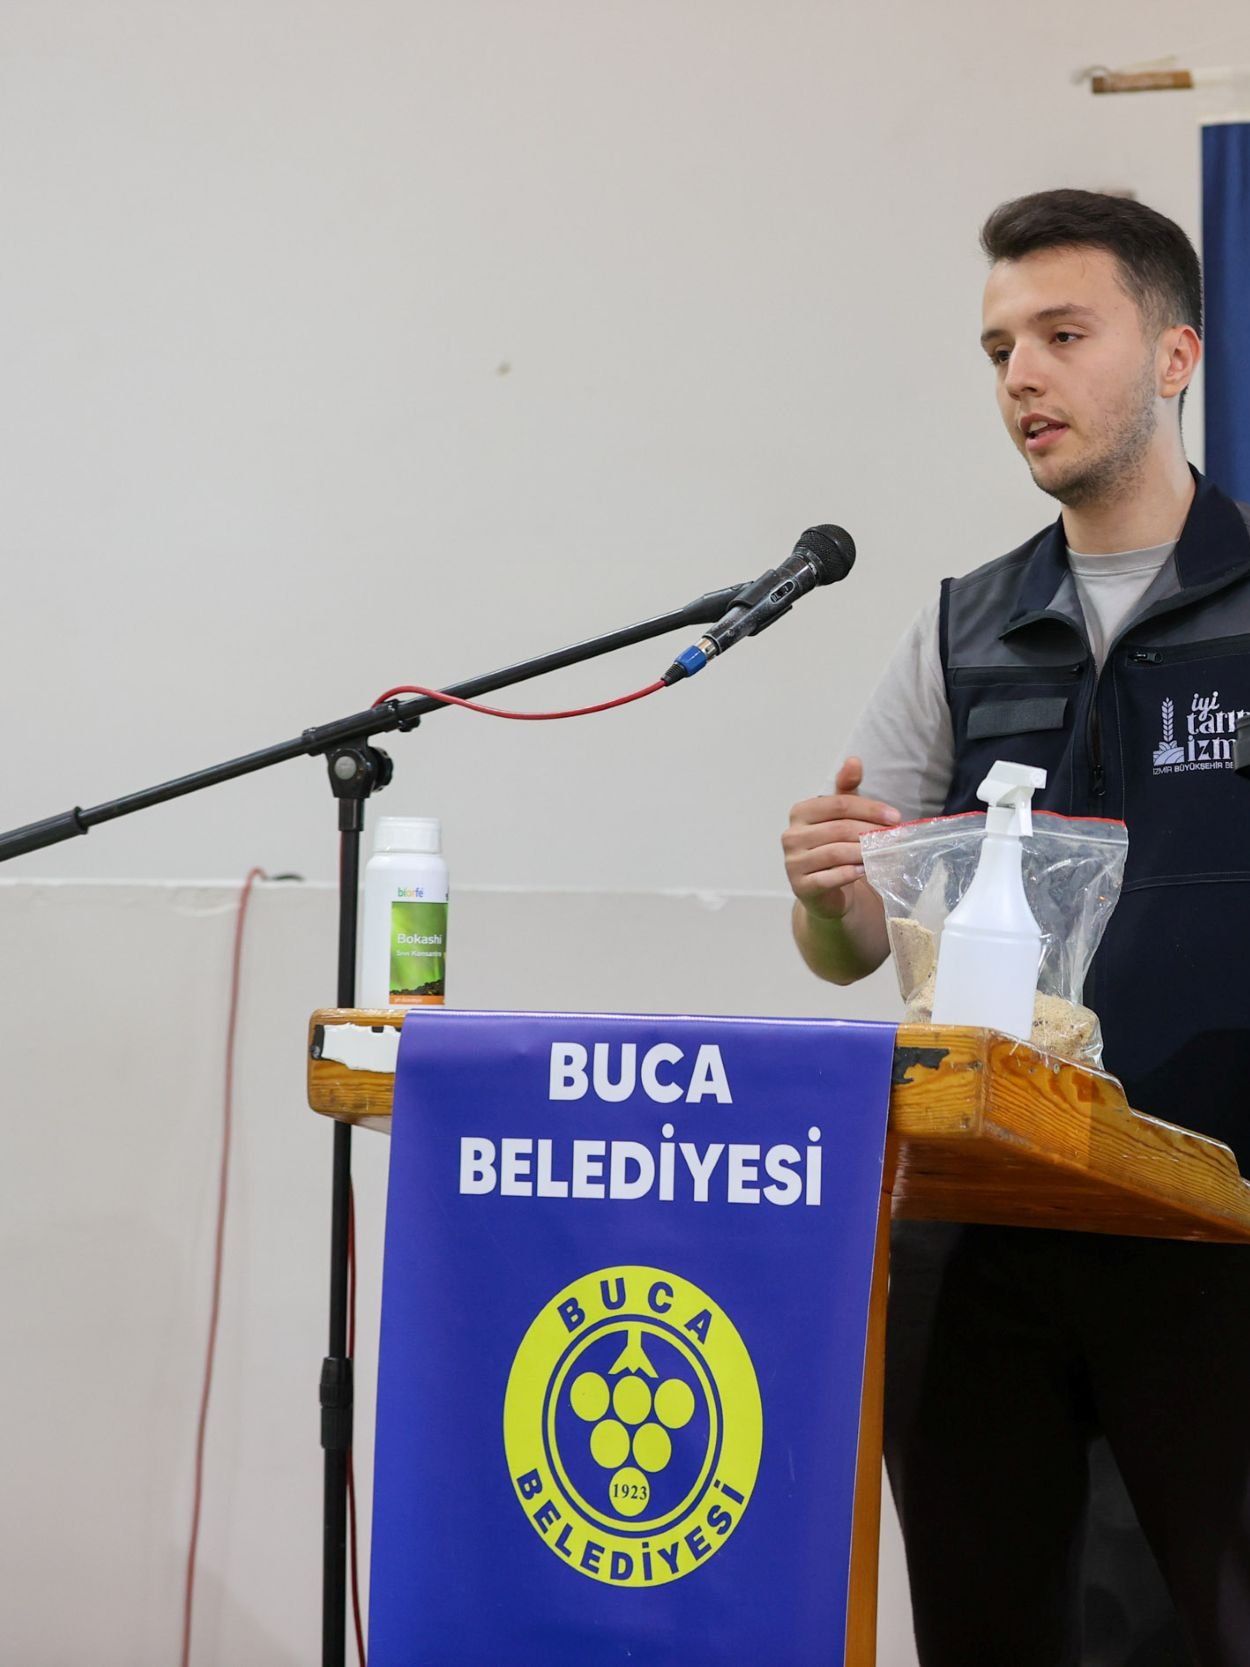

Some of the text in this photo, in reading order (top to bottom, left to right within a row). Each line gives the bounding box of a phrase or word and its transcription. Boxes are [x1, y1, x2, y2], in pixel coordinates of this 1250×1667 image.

[1191, 690, 1220, 721] iyi
[397, 933, 443, 945] Bokashi
[549, 1042, 733, 1104] BUCA
[459, 1123, 822, 1206] BELEDİYESİ
[556, 1277, 713, 1344] BUCA
[612, 1483, 648, 1501] 1923
[516, 1467, 745, 1581] BELEDİYESİ
